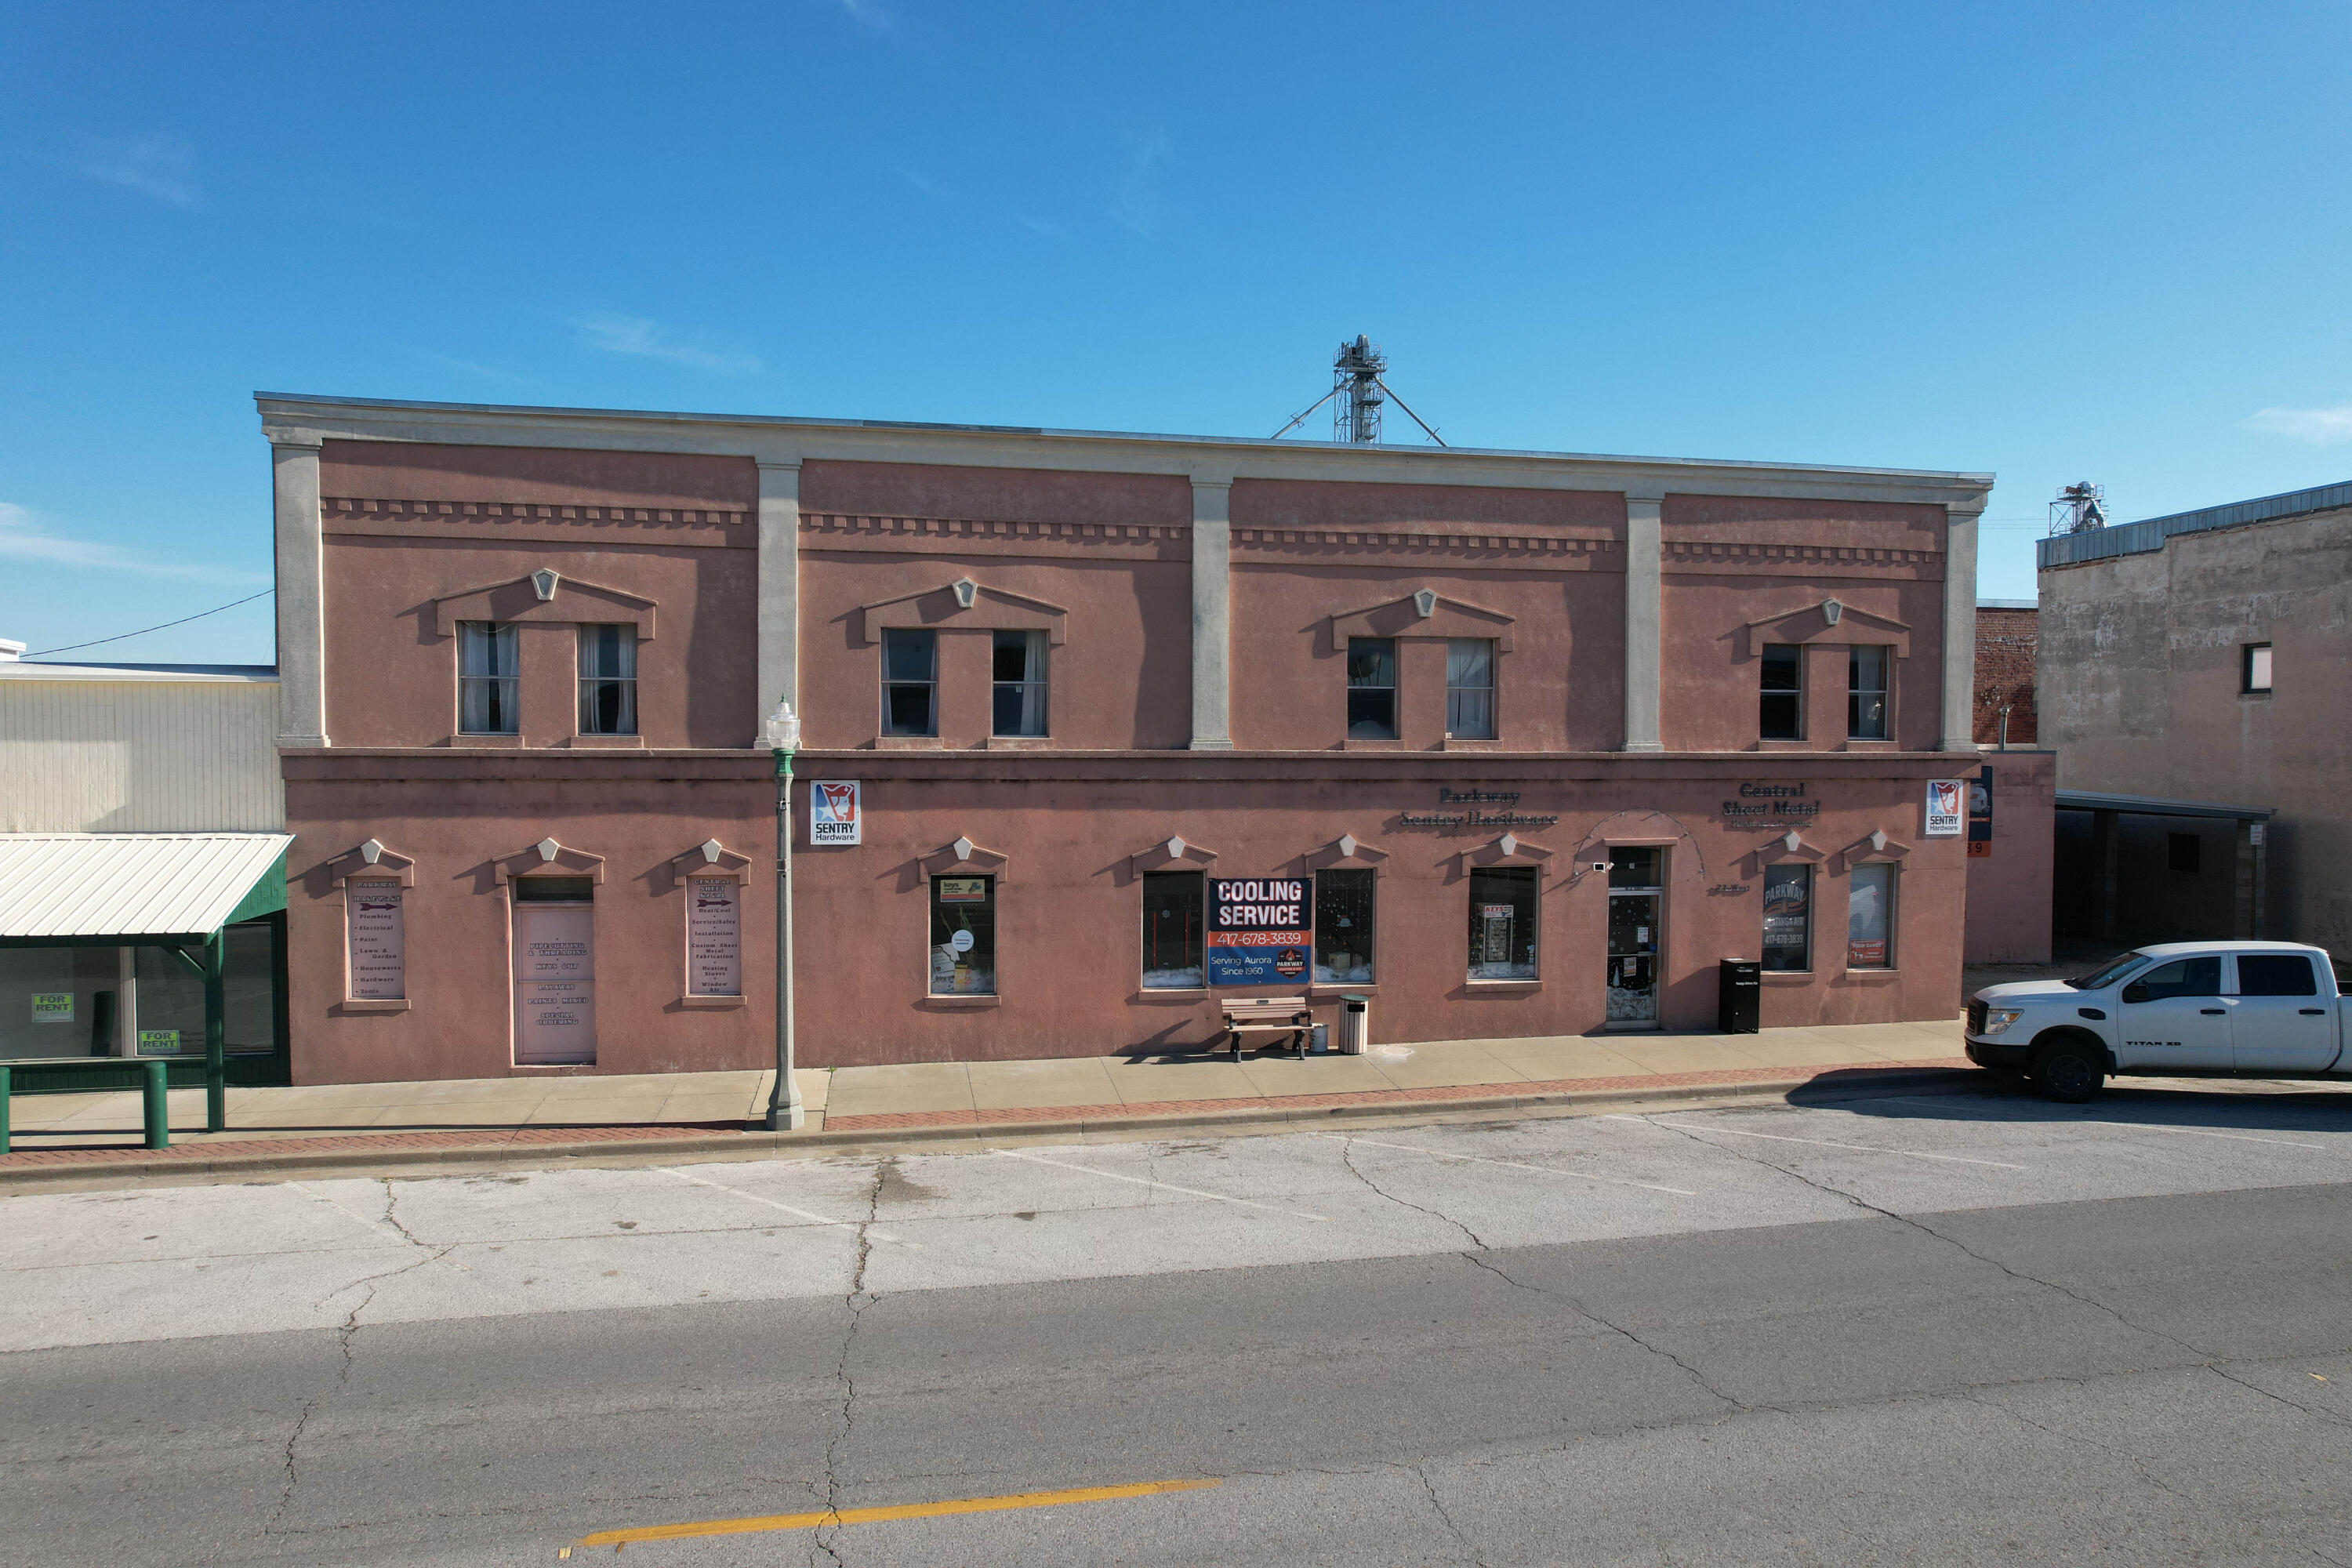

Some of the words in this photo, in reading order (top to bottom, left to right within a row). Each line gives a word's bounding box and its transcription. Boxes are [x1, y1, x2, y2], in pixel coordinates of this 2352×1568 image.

[1740, 783, 1806, 797] Central
[1440, 788, 1519, 807] Parkway
[1723, 801, 1769, 816] Sheet
[1773, 800, 1820, 815] Metal
[1402, 811, 1463, 830] Sentry
[1468, 811, 1559, 825] Hardware
[1930, 816, 1958, 825] SENTRY
[816, 823, 855, 833] SENTRY
[1218, 881, 1301, 902] COOLING
[1765, 884, 1804, 905] PARKWAY
[1218, 905, 1301, 926] SERVICE
[1764, 917, 1788, 927] HEATING
[1794, 916, 1804, 926] AIR
[1217, 932, 1301, 946] 417-678-3839
[1765, 935, 1803, 945] 417-678-3839
[1210, 956, 1242, 966] Serving
